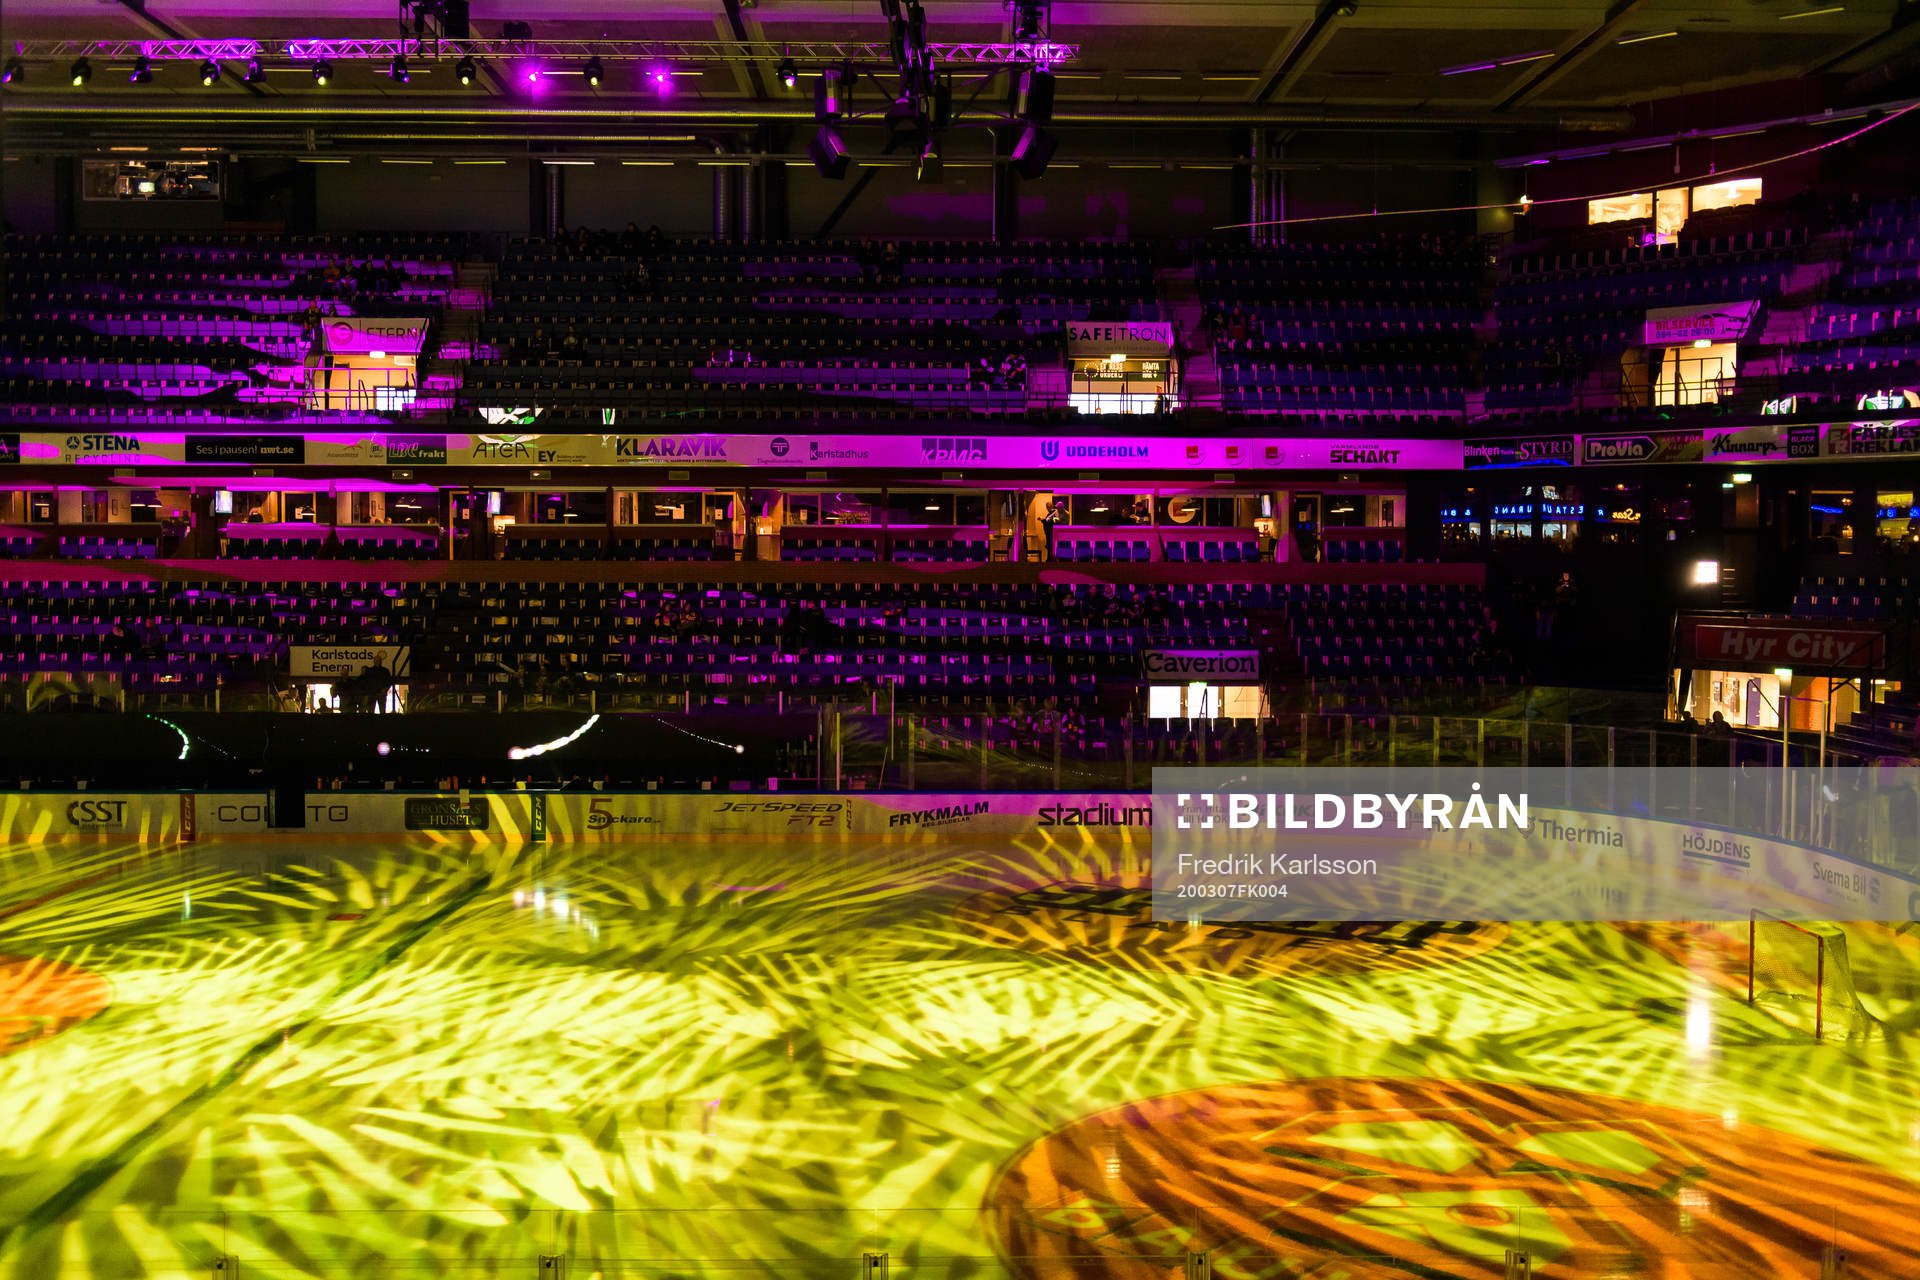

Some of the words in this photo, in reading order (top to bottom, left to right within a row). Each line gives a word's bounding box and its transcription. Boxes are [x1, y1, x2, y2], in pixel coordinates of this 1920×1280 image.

[83, 435, 140, 451] STENA
[616, 438, 727, 456] KLARAVIK
[1520, 441, 1572, 460] STYRD
[1590, 440, 1643, 457] ProVia
[1791, 444, 1815, 455] BOX
[196, 445, 213, 455] Ses
[219, 445, 257, 457] pausen!
[260, 446, 294, 455] nwt.se
[418, 449, 445, 459] frakt
[538, 451, 556, 462] EY
[810, 446, 869, 460] Karlstadhus
[921, 449, 984, 464] KPMG
[1066, 445, 1149, 457] UDDEHOLM
[1329, 450, 1400, 464] SCHAKT
[1464, 445, 1500, 463] Blinken
[65, 454, 141, 464] RECYCLING
[1721, 629, 1778, 660] Hyr
[1787, 632, 1857, 664] City
[312, 649, 374, 660] Karlstads
[1145, 652, 1257, 673] Caverion
[430, 815, 471, 825] HUSET
[787, 815, 836, 827] FT2
[889, 800, 990, 828] FRYKMALM
[1037, 802, 1153, 827] stadium
[1538, 818, 1624, 848] Thermia
[1683, 832, 1751, 860] HÖJDENS
[1853, 874, 1867, 896] Bil
